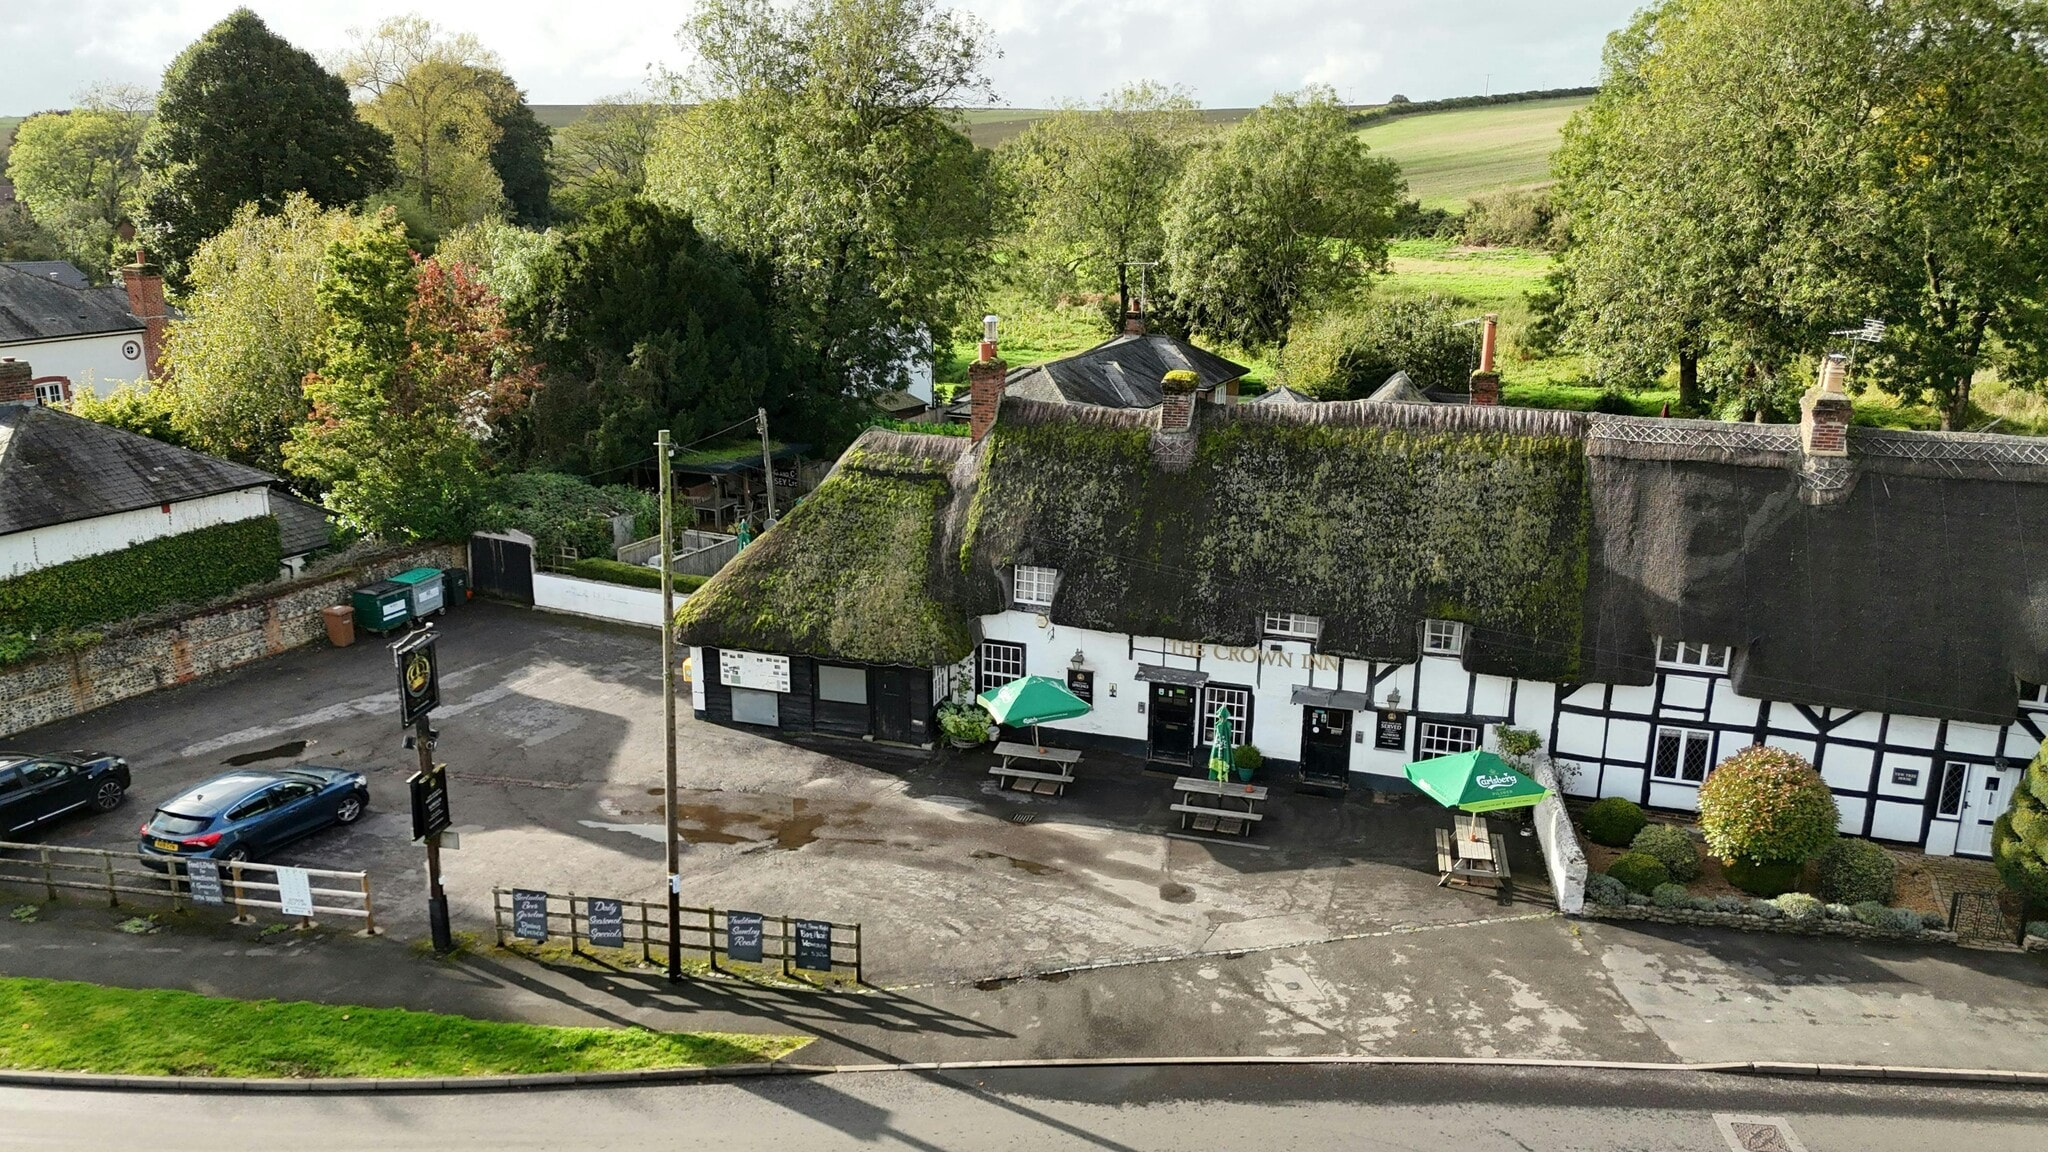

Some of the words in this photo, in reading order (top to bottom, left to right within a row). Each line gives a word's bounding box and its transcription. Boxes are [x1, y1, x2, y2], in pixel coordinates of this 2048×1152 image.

[1171, 639, 1206, 658] THE
[1213, 646, 1293, 668] CROWN
[1301, 653, 1338, 672] INN
[1476, 772, 1517, 789] Carlsberg
[521, 901, 538, 910] Beer
[594, 901, 617, 915] Daily
[516, 910, 545, 921] Garden
[589, 915, 622, 925] Seasonal
[728, 916, 763, 924] Traditional
[590, 928, 622, 940] Specials
[731, 926, 761, 938] Sunday
[734, 936, 758, 947] Roast
